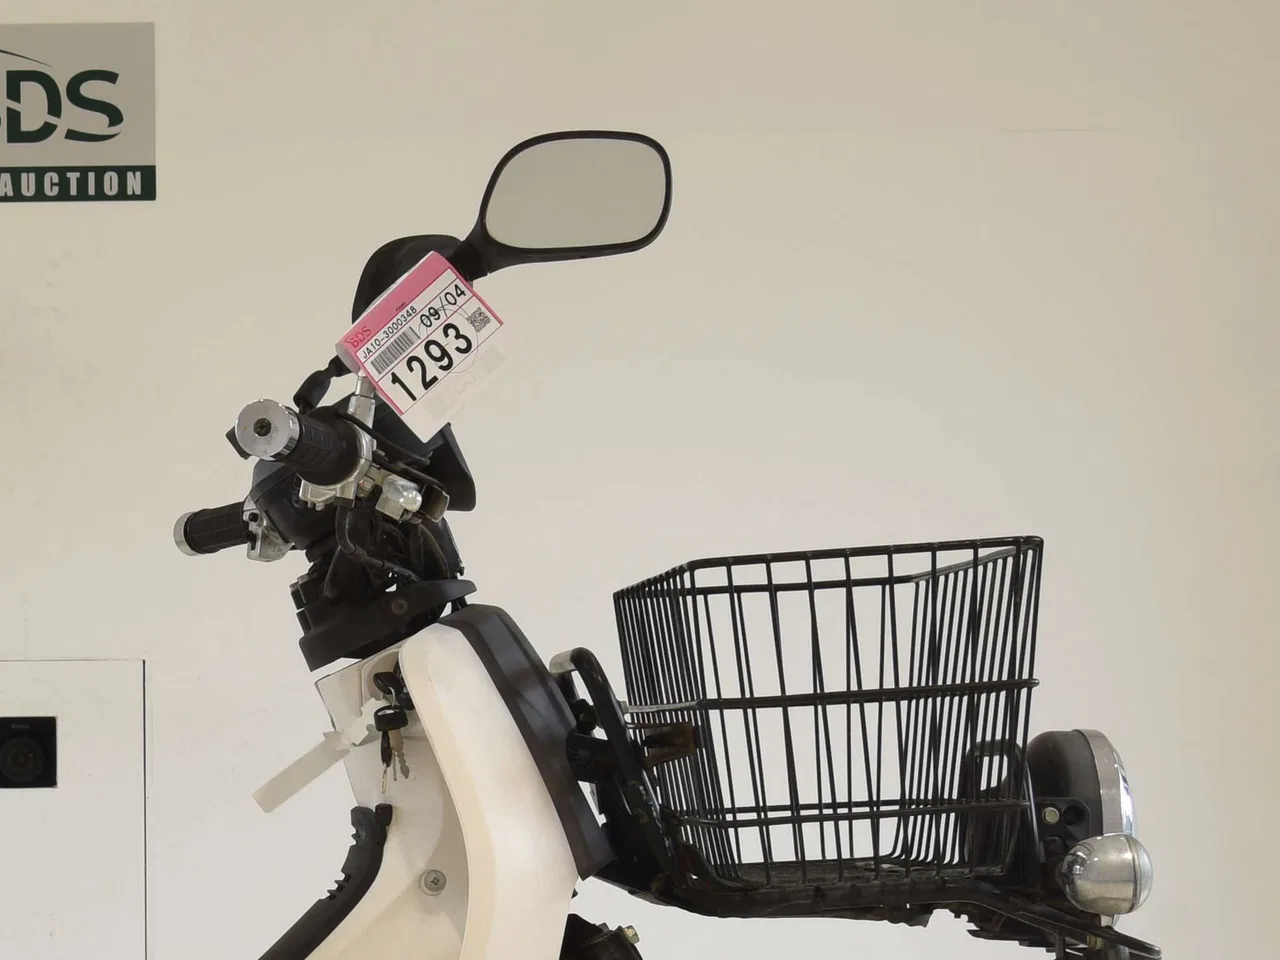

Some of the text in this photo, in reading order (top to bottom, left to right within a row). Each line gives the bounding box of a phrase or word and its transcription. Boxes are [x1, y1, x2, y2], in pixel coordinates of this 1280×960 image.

[345, 325, 372, 349] BDS
[362, 305, 418, 359] JA10-3000348
[390, 322, 473, 402] 1293
